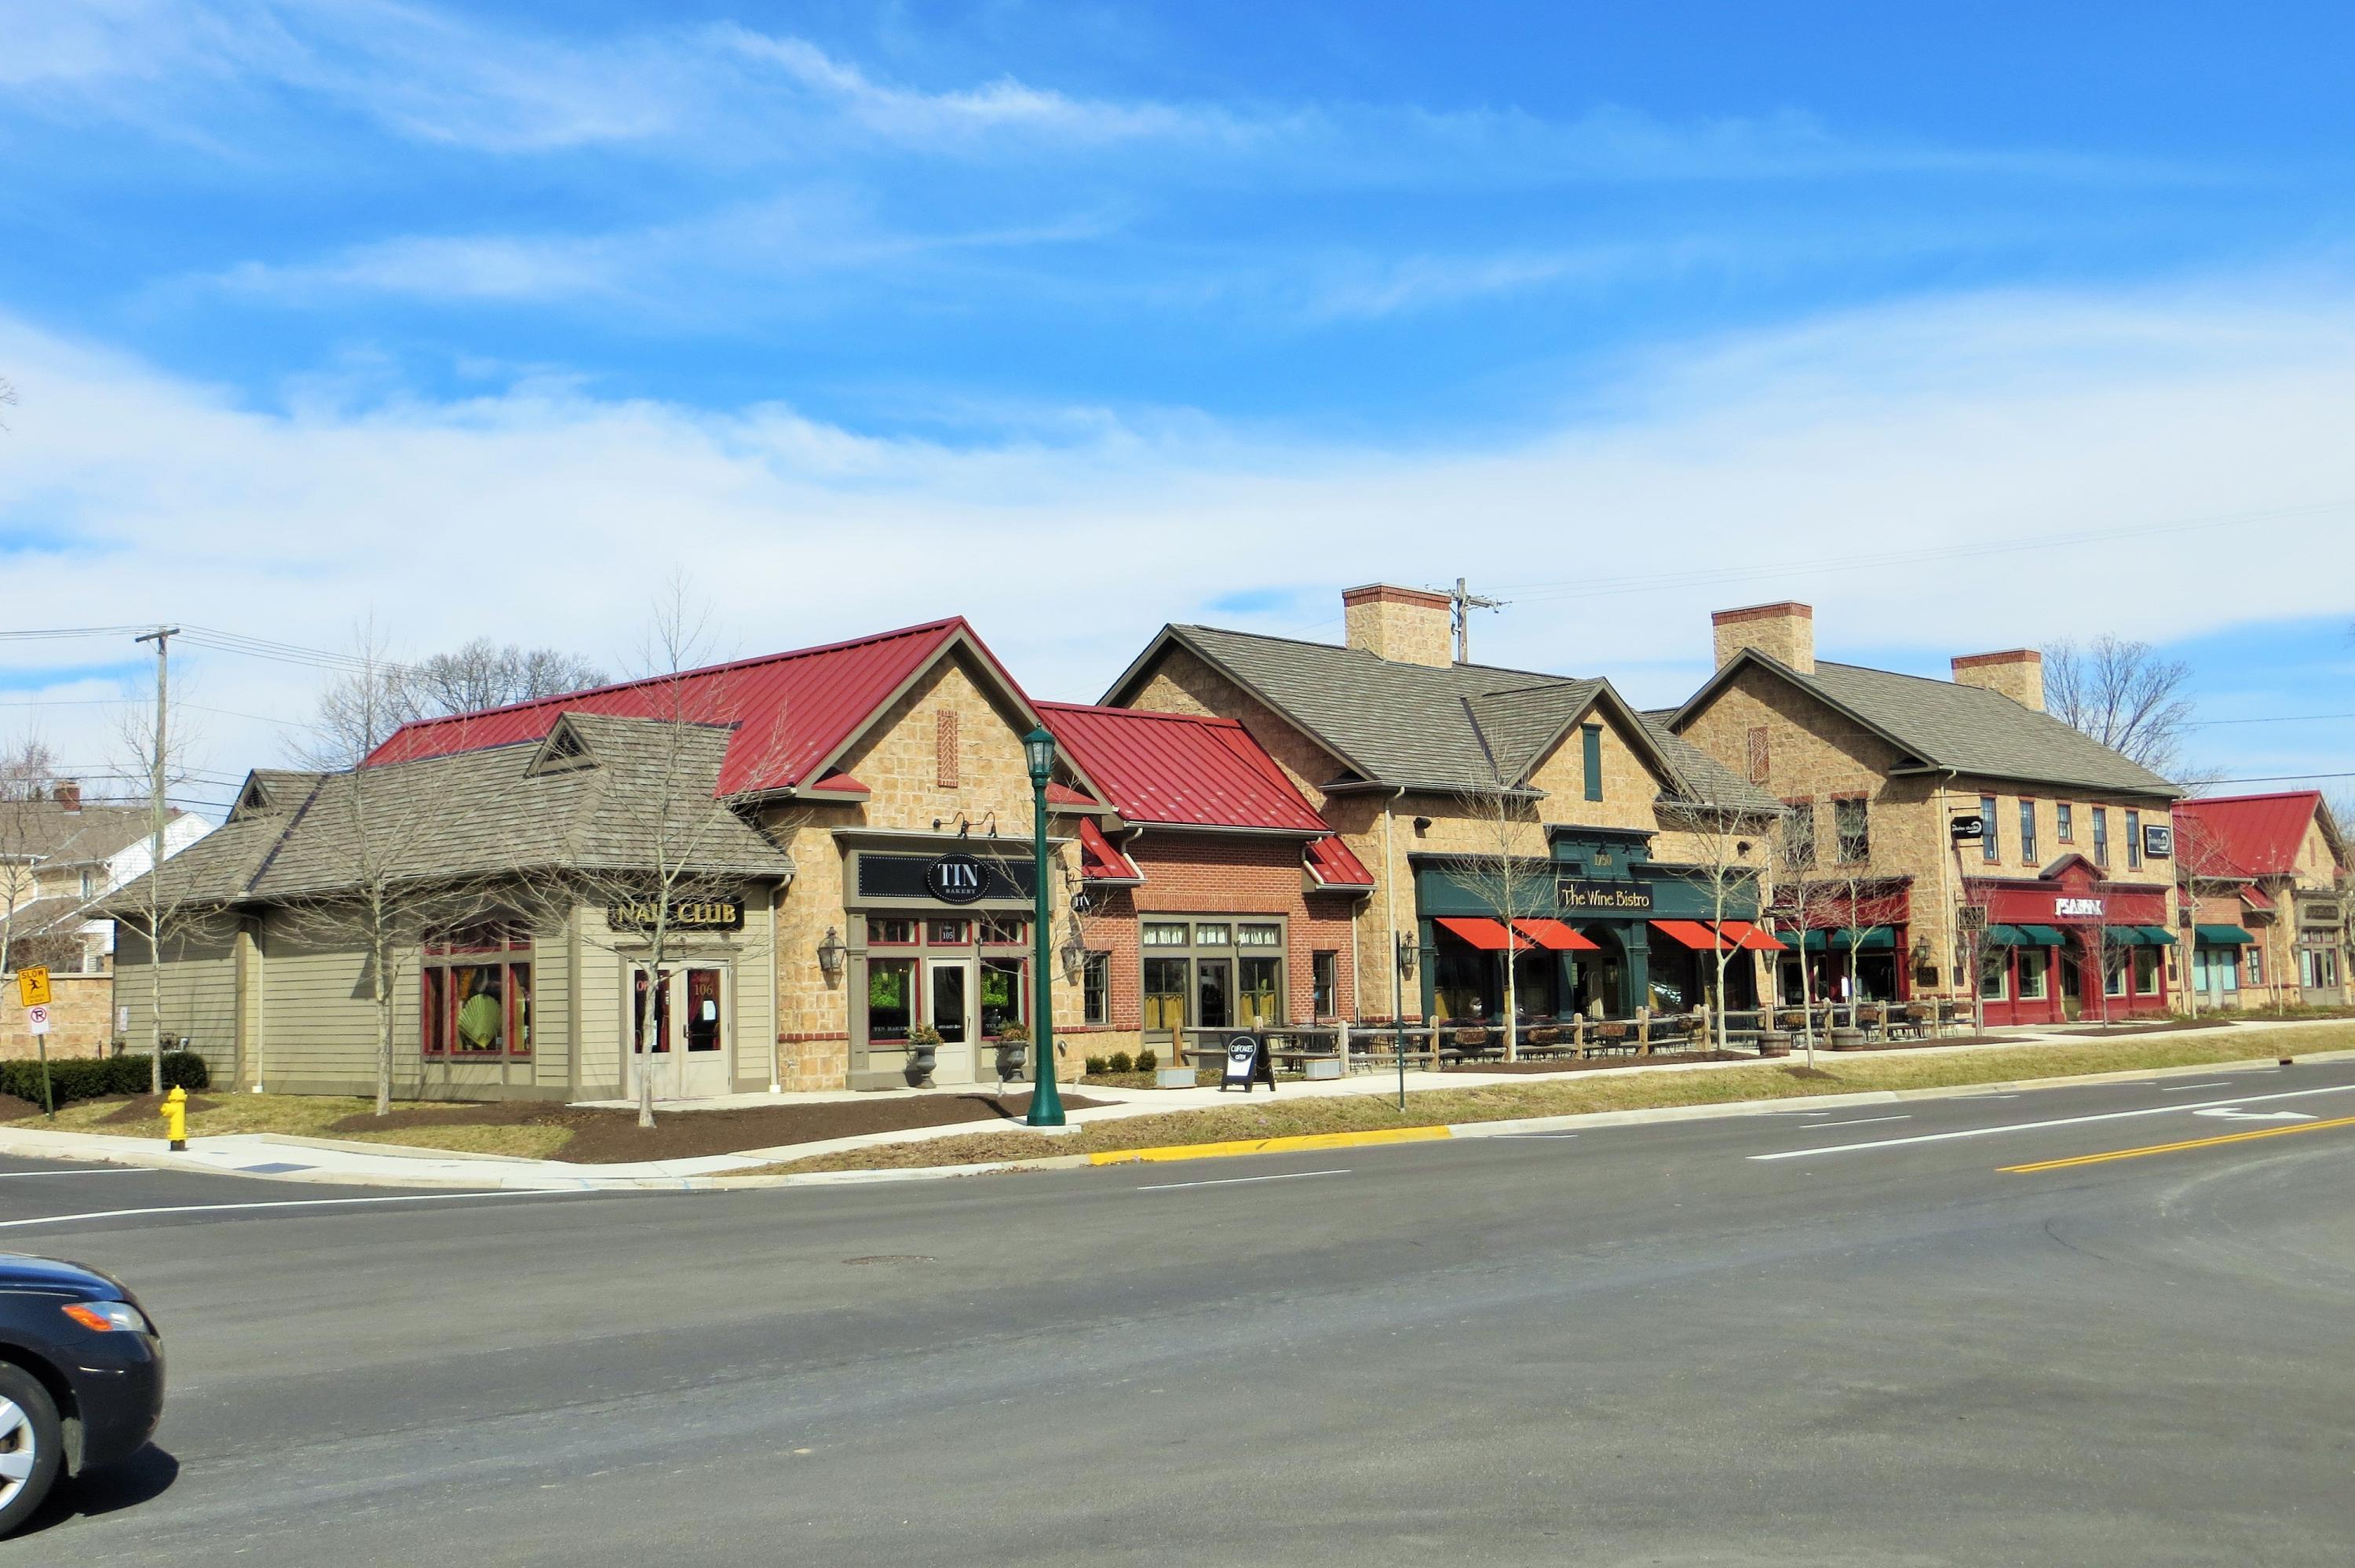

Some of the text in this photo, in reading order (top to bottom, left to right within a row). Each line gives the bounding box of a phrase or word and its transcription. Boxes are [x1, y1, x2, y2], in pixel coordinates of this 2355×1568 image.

[1594, 854, 1612, 866] 1750
[937, 863, 978, 886] TIN
[1562, 884, 1649, 907] The Wine Bistro
[618, 903, 736, 923] NAI CLUB
[21, 970, 44, 979] SLOW
[695, 984, 713, 995] 106
